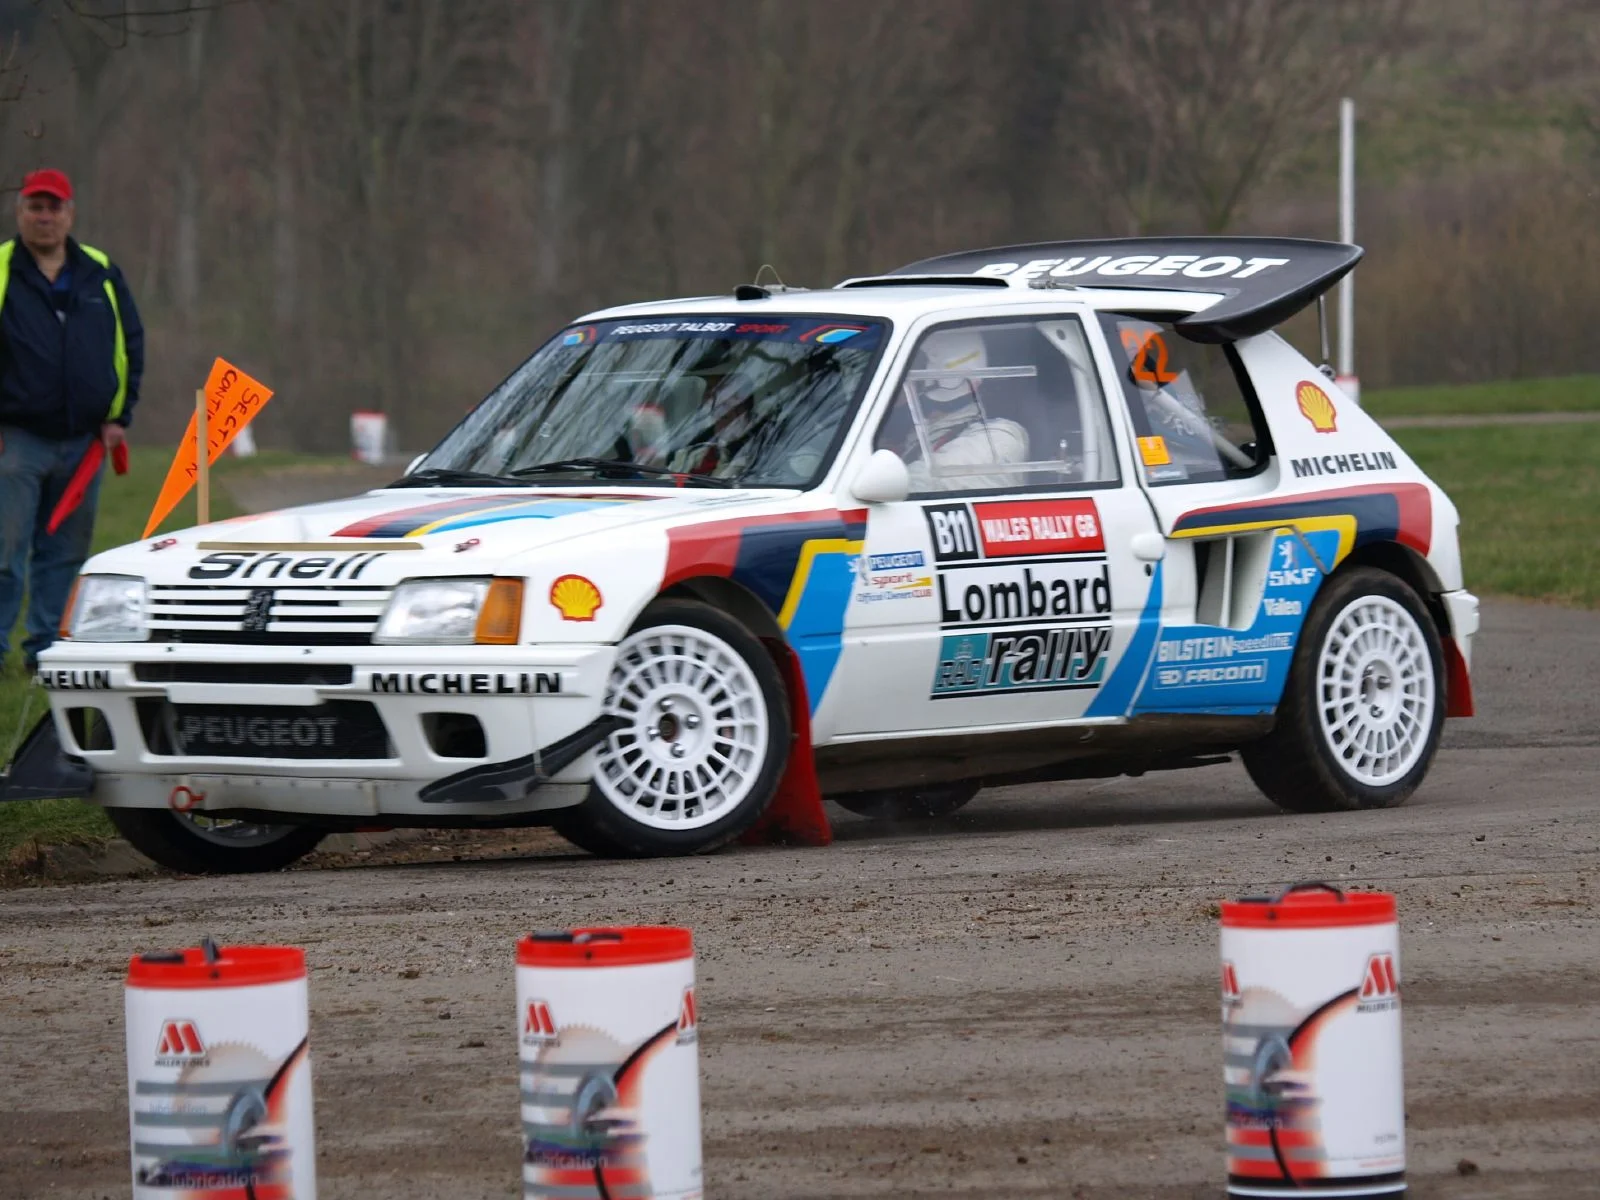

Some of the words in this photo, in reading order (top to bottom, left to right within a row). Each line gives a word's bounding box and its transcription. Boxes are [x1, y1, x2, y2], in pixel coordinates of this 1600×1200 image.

[971, 256, 1290, 279] PEUGEOT
[610, 324, 677, 335] PEUGEOT
[676, 323, 736, 332] TALBOT
[735, 324, 790, 334] SPORT
[1290, 450, 1398, 478] MICHELIN
[930, 510, 975, 554] B11
[981, 518, 1031, 543] WALES
[1030, 515, 1074, 540] RALLY
[1074, 514, 1099, 538] GB
[187, 552, 389, 580] Shell
[1268, 568, 1317, 587] SKF
[937, 564, 1113, 623] Lombard
[984, 627, 1113, 687] rally
[1158, 636, 1235, 663] BILSTEIN
[33, 670, 112, 690] HELIN
[372, 671, 561, 694] MICHELIN
[180, 715, 338, 747] PEUGEOT
